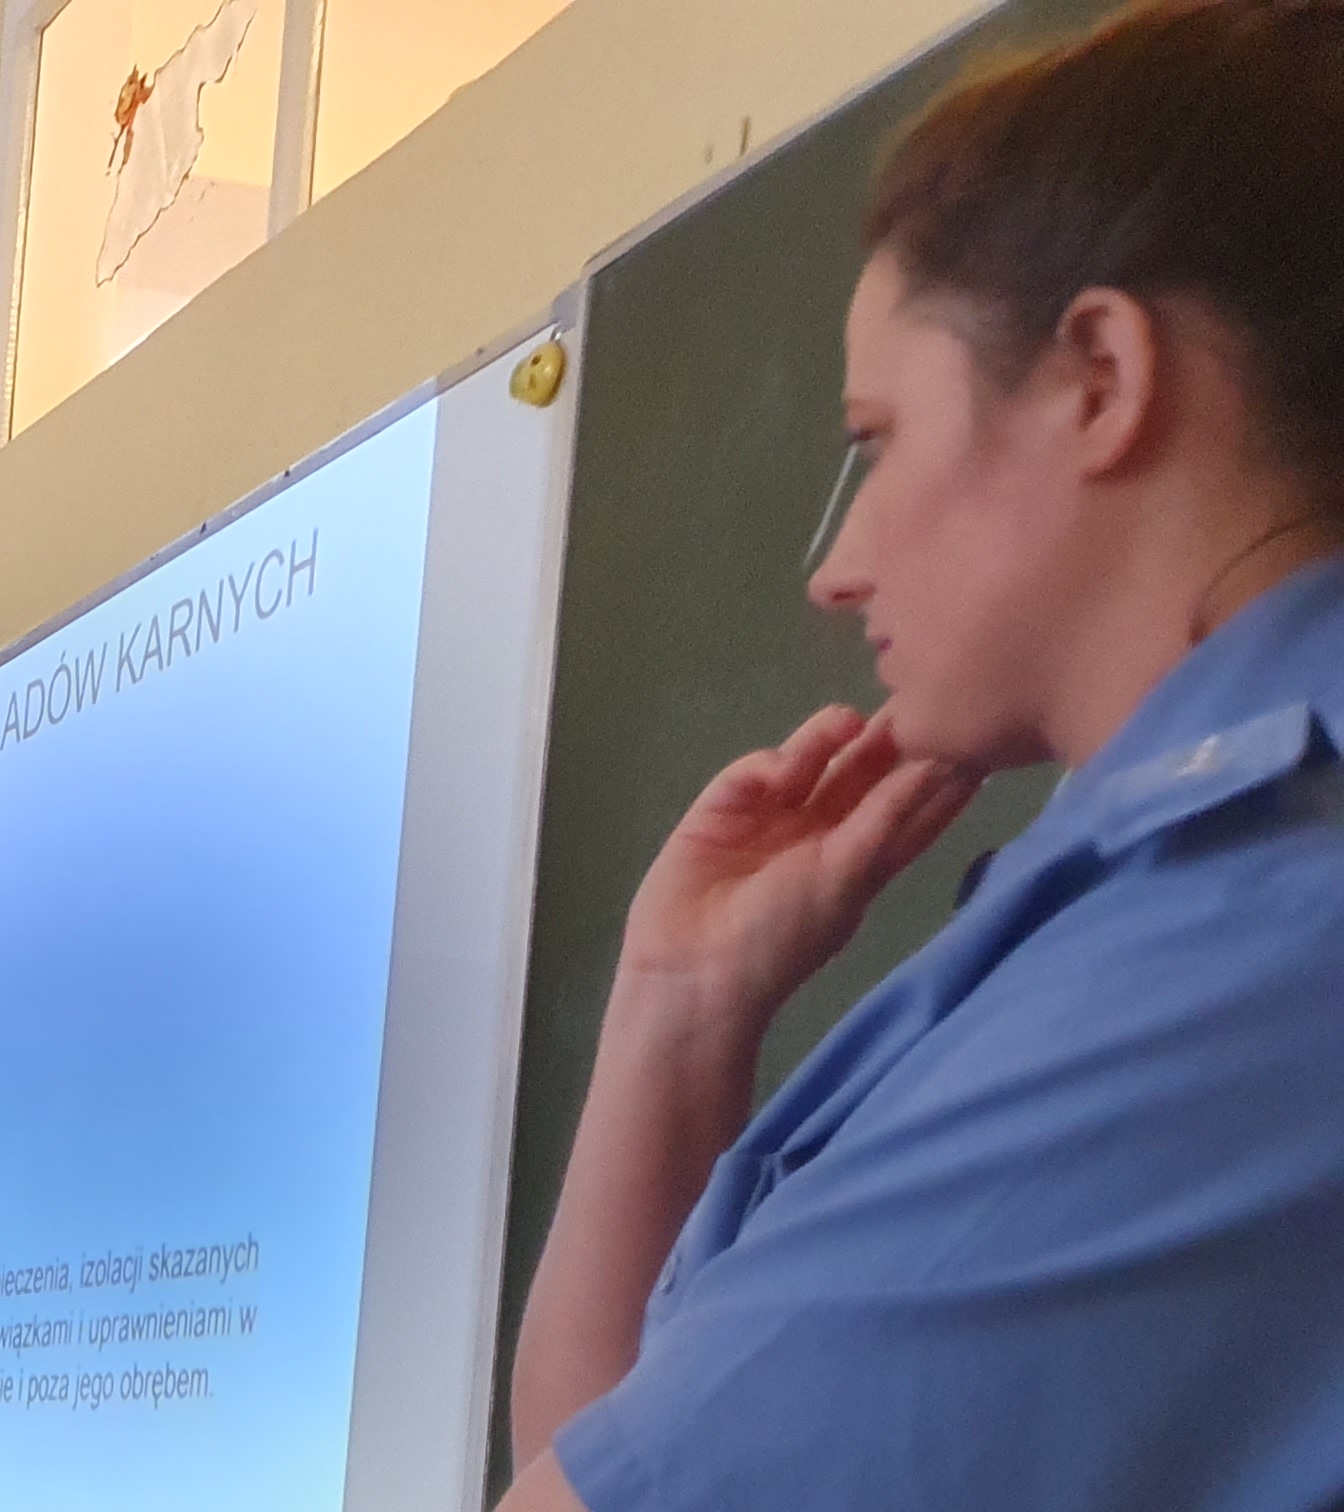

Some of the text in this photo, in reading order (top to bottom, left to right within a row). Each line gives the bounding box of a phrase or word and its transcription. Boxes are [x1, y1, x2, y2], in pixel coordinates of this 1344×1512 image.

[115, 527, 320, 694] KARNYCH
[80, 1246, 144, 1294] izolacji
[148, 1231, 260, 1287] skazanych
[88, 1298, 233, 1352] uprawnieniami
[239, 1305, 258, 1335] w
[26, 1373, 70, 1410] poza
[73, 1365, 115, 1411] jego
[120, 1361, 214, 1410] obrębem.
